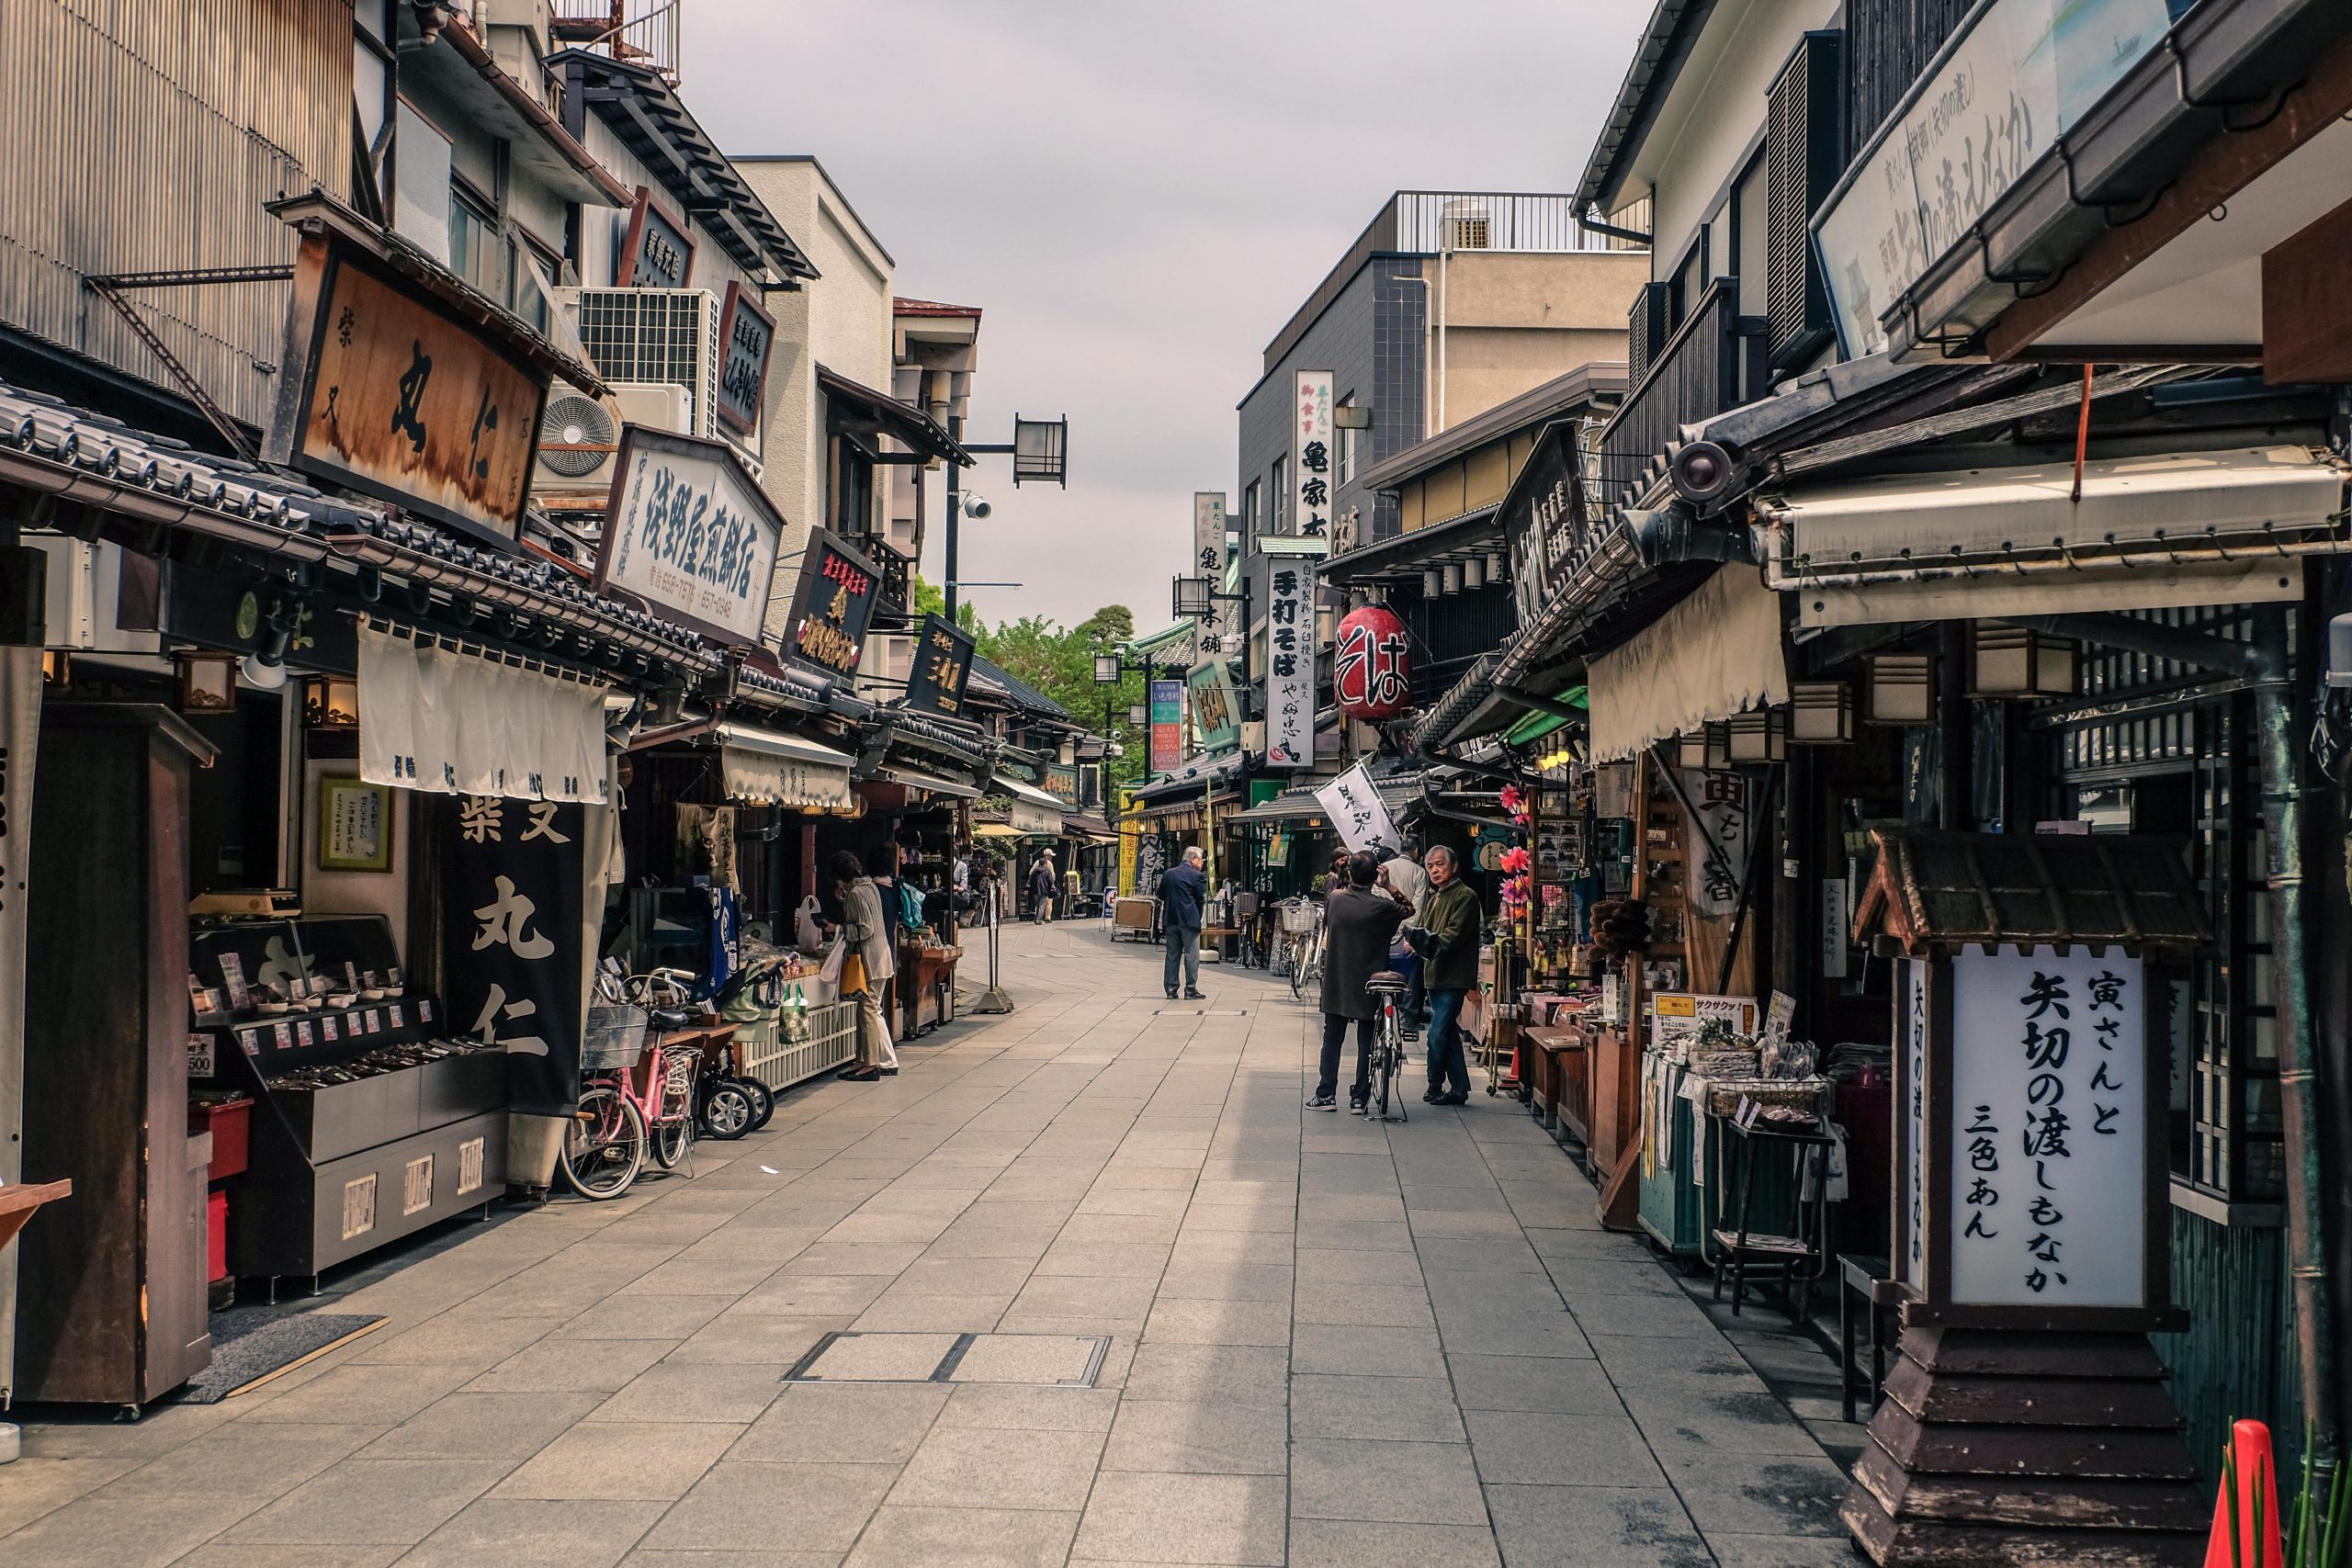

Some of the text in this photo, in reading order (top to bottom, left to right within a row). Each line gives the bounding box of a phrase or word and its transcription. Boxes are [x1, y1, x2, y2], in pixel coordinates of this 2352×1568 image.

[1301, 384, 1314, 434] 御食事
[1212, 502, 1221, 540] 草だんご
[1301, 440, 1329, 562] 亀家本
[1272, 570, 1297, 678] 手打そば
[1300, 564, 1313, 669] 自家製粉 石臼挽き
[1335, 625, 1411, 708] そば
[460, 795, 571, 844] 柴又
[470, 874, 556, 1057] 丸仁
[2087, 971, 2127, 1135] 寅さんと
[1964, 1105, 1999, 1239] 三色あん
[2020, 971, 2071, 1293] 矢切の渡しもなか
